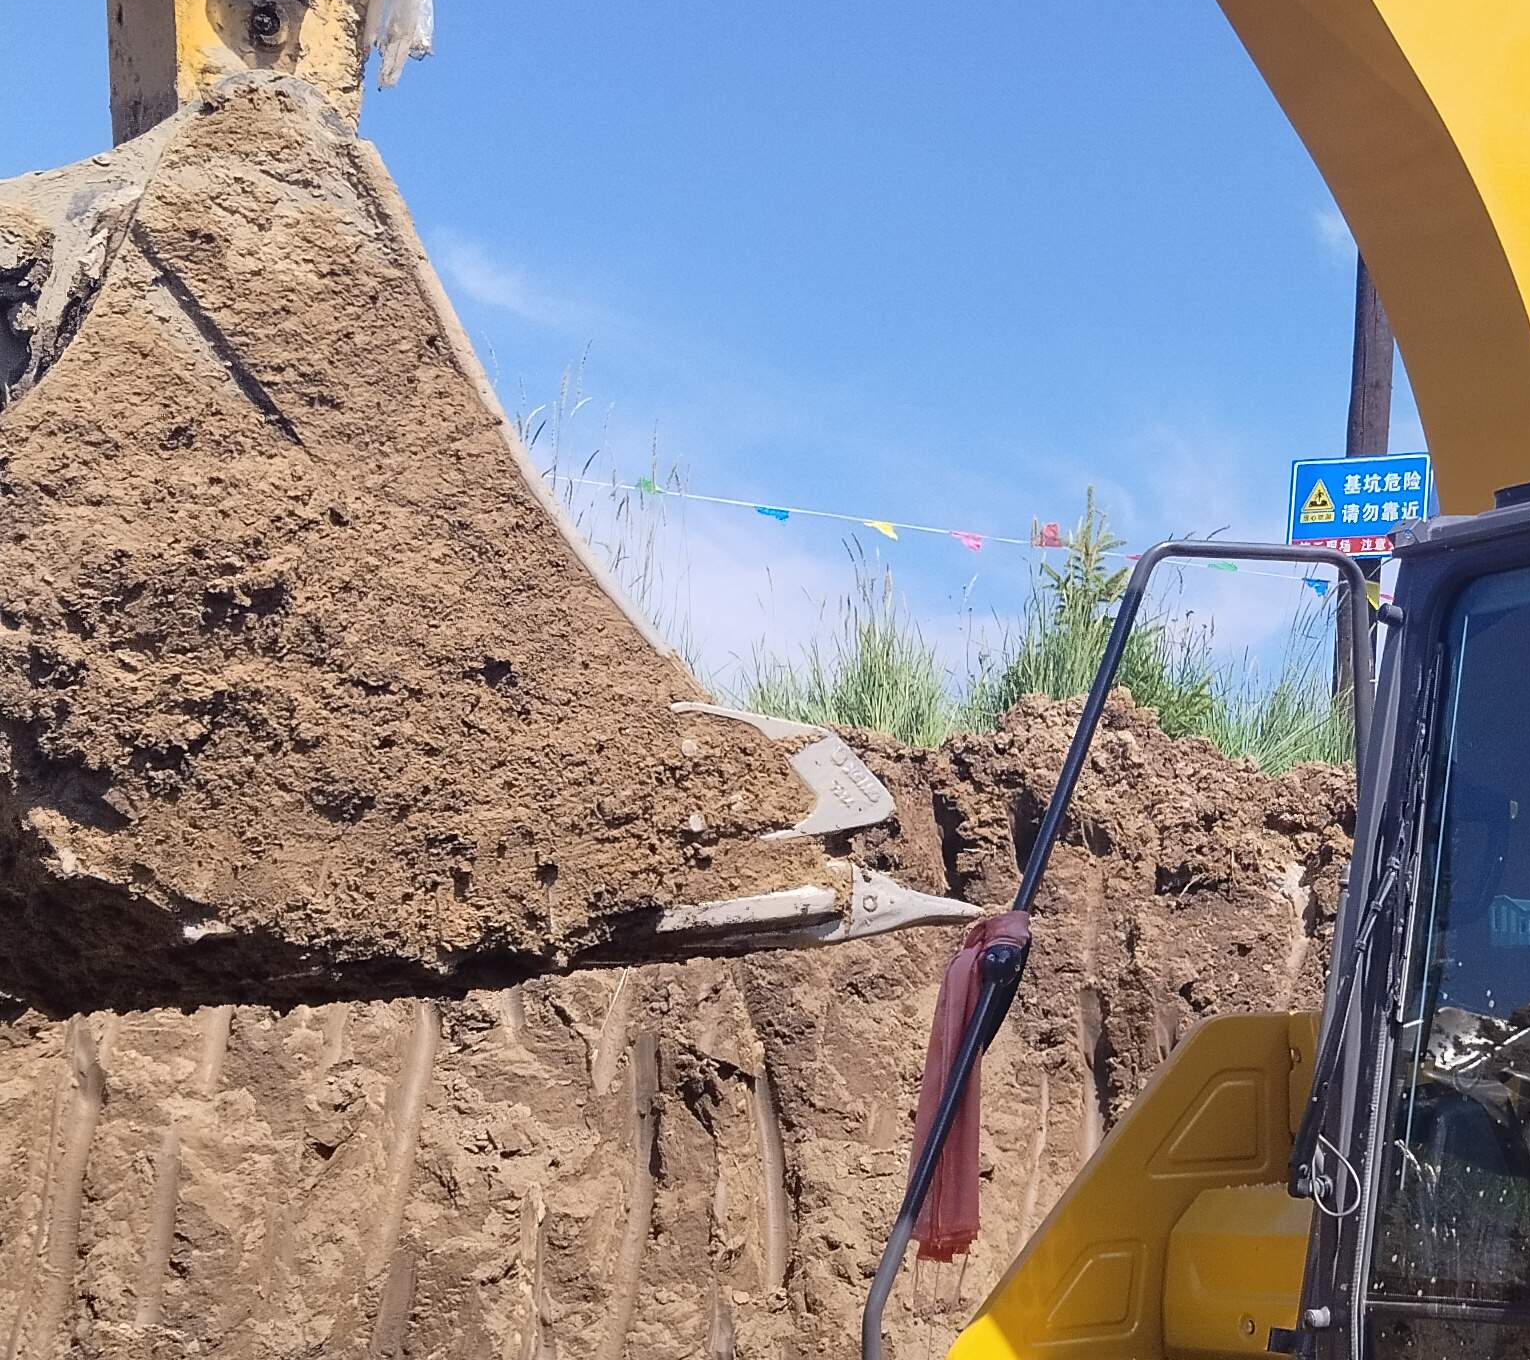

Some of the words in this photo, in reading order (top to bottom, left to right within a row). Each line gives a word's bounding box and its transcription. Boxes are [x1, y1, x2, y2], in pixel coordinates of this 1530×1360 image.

[1343, 470, 1422, 495] 基坑危险
[1341, 500, 1420, 524] 请勿靠近
